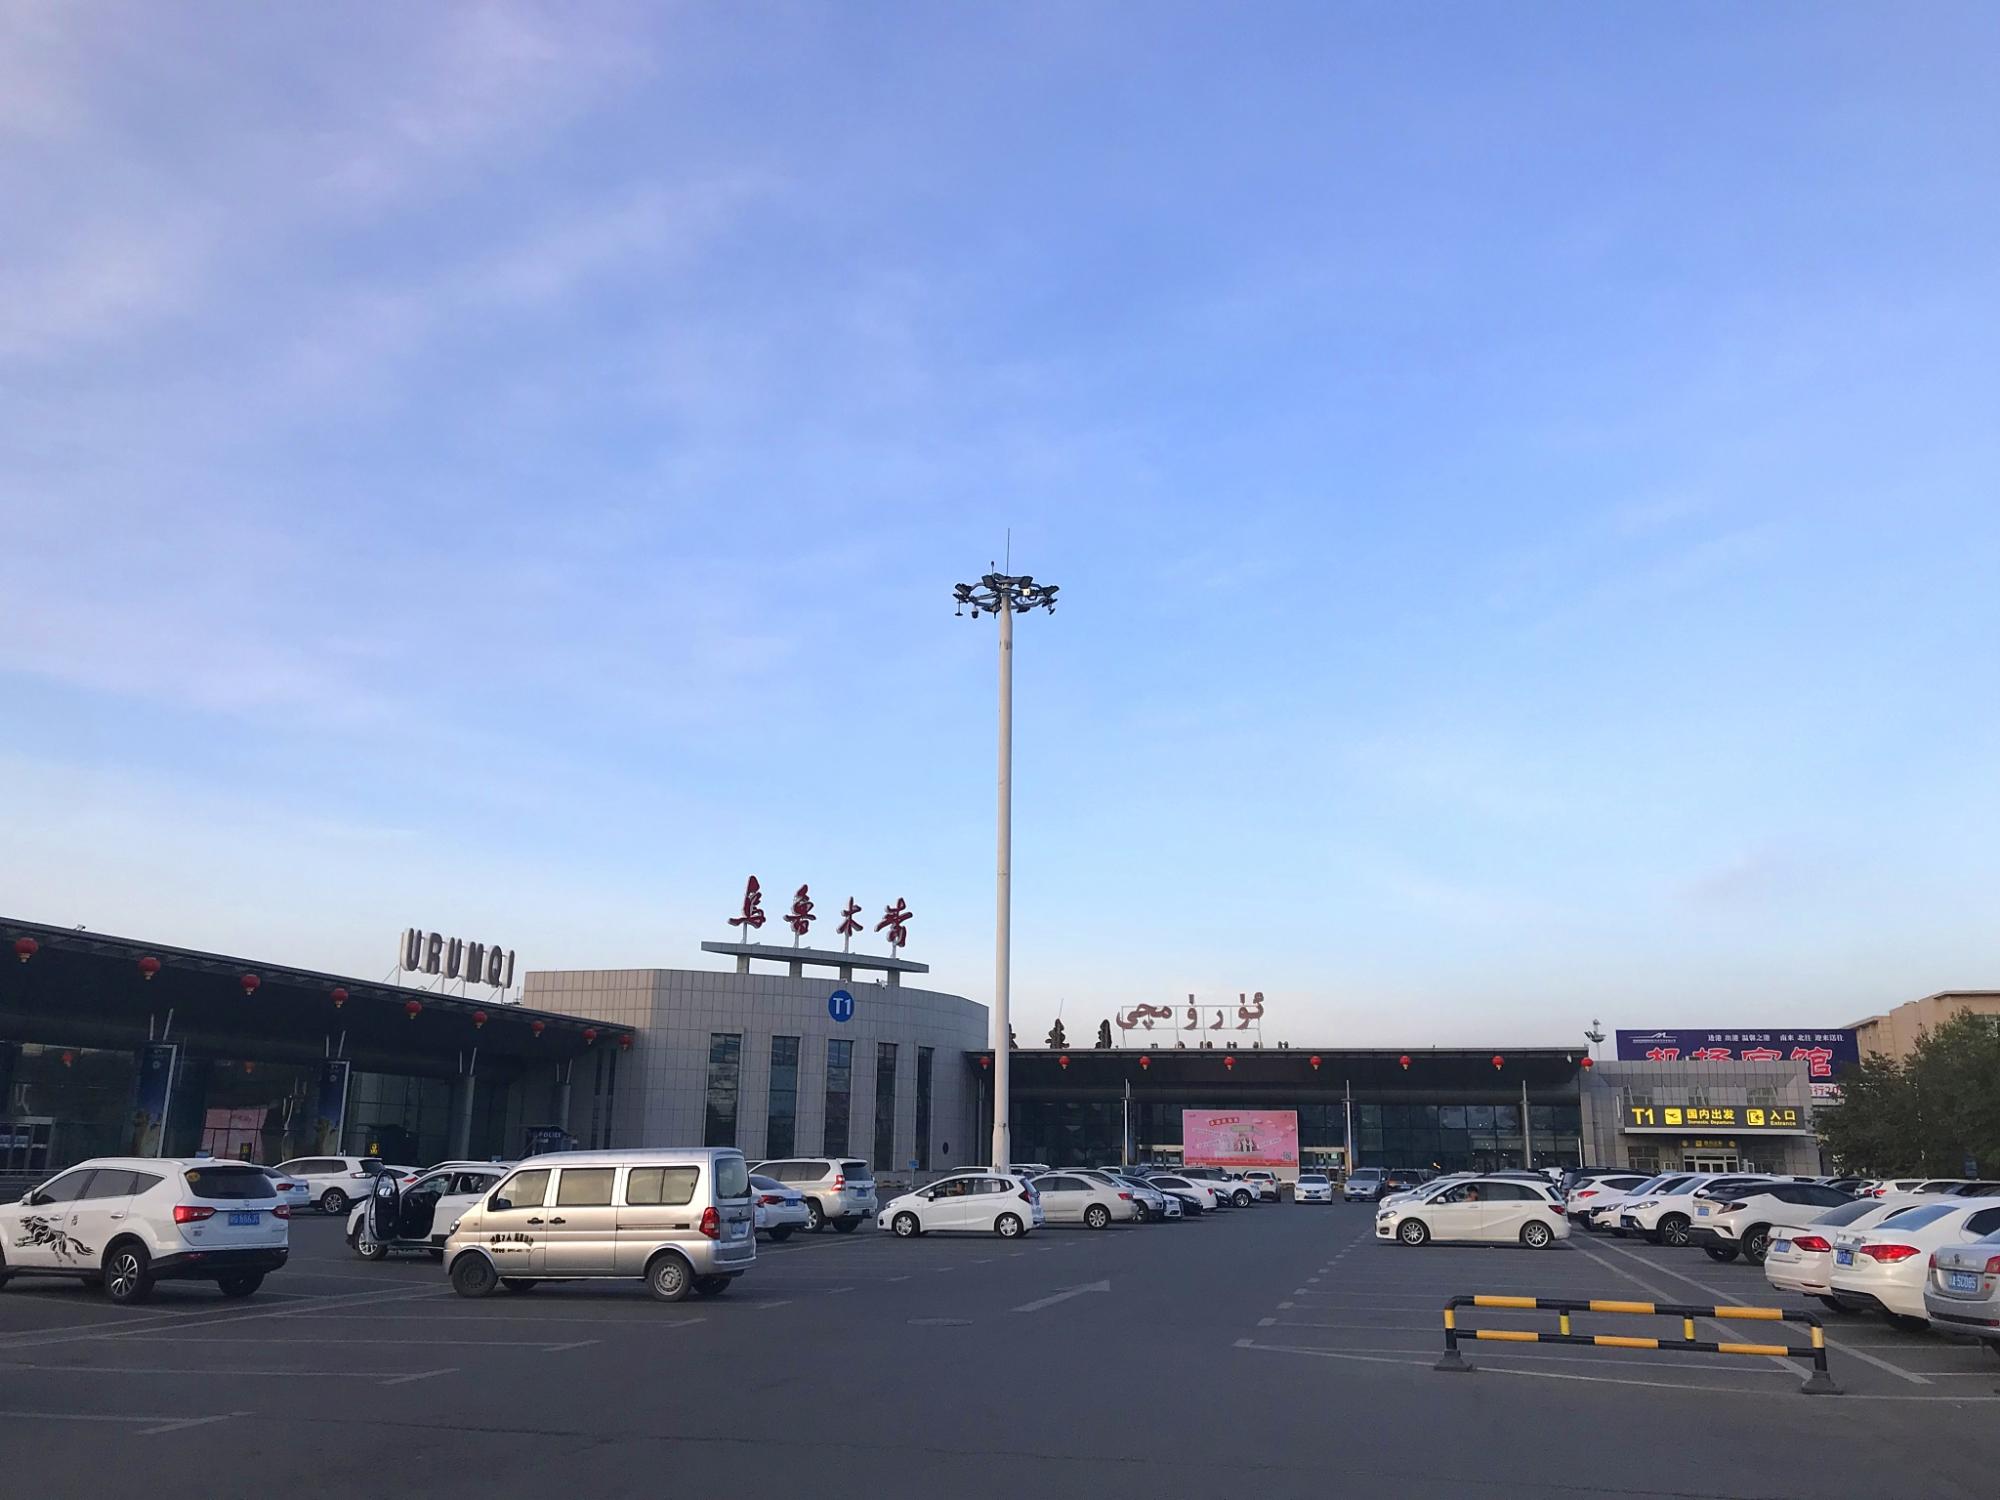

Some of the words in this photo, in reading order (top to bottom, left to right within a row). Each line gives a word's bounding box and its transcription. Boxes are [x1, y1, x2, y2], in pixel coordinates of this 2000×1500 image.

[727, 875, 914, 947] 乌鲁木齐
[401, 927, 515, 989] URUMQI
[832, 997, 851, 1016] T1
[1631, 1108, 1655, 1125] T1
[1686, 1108, 1735, 1120] 国内出发
[1770, 1110, 1796, 1121] 入口
